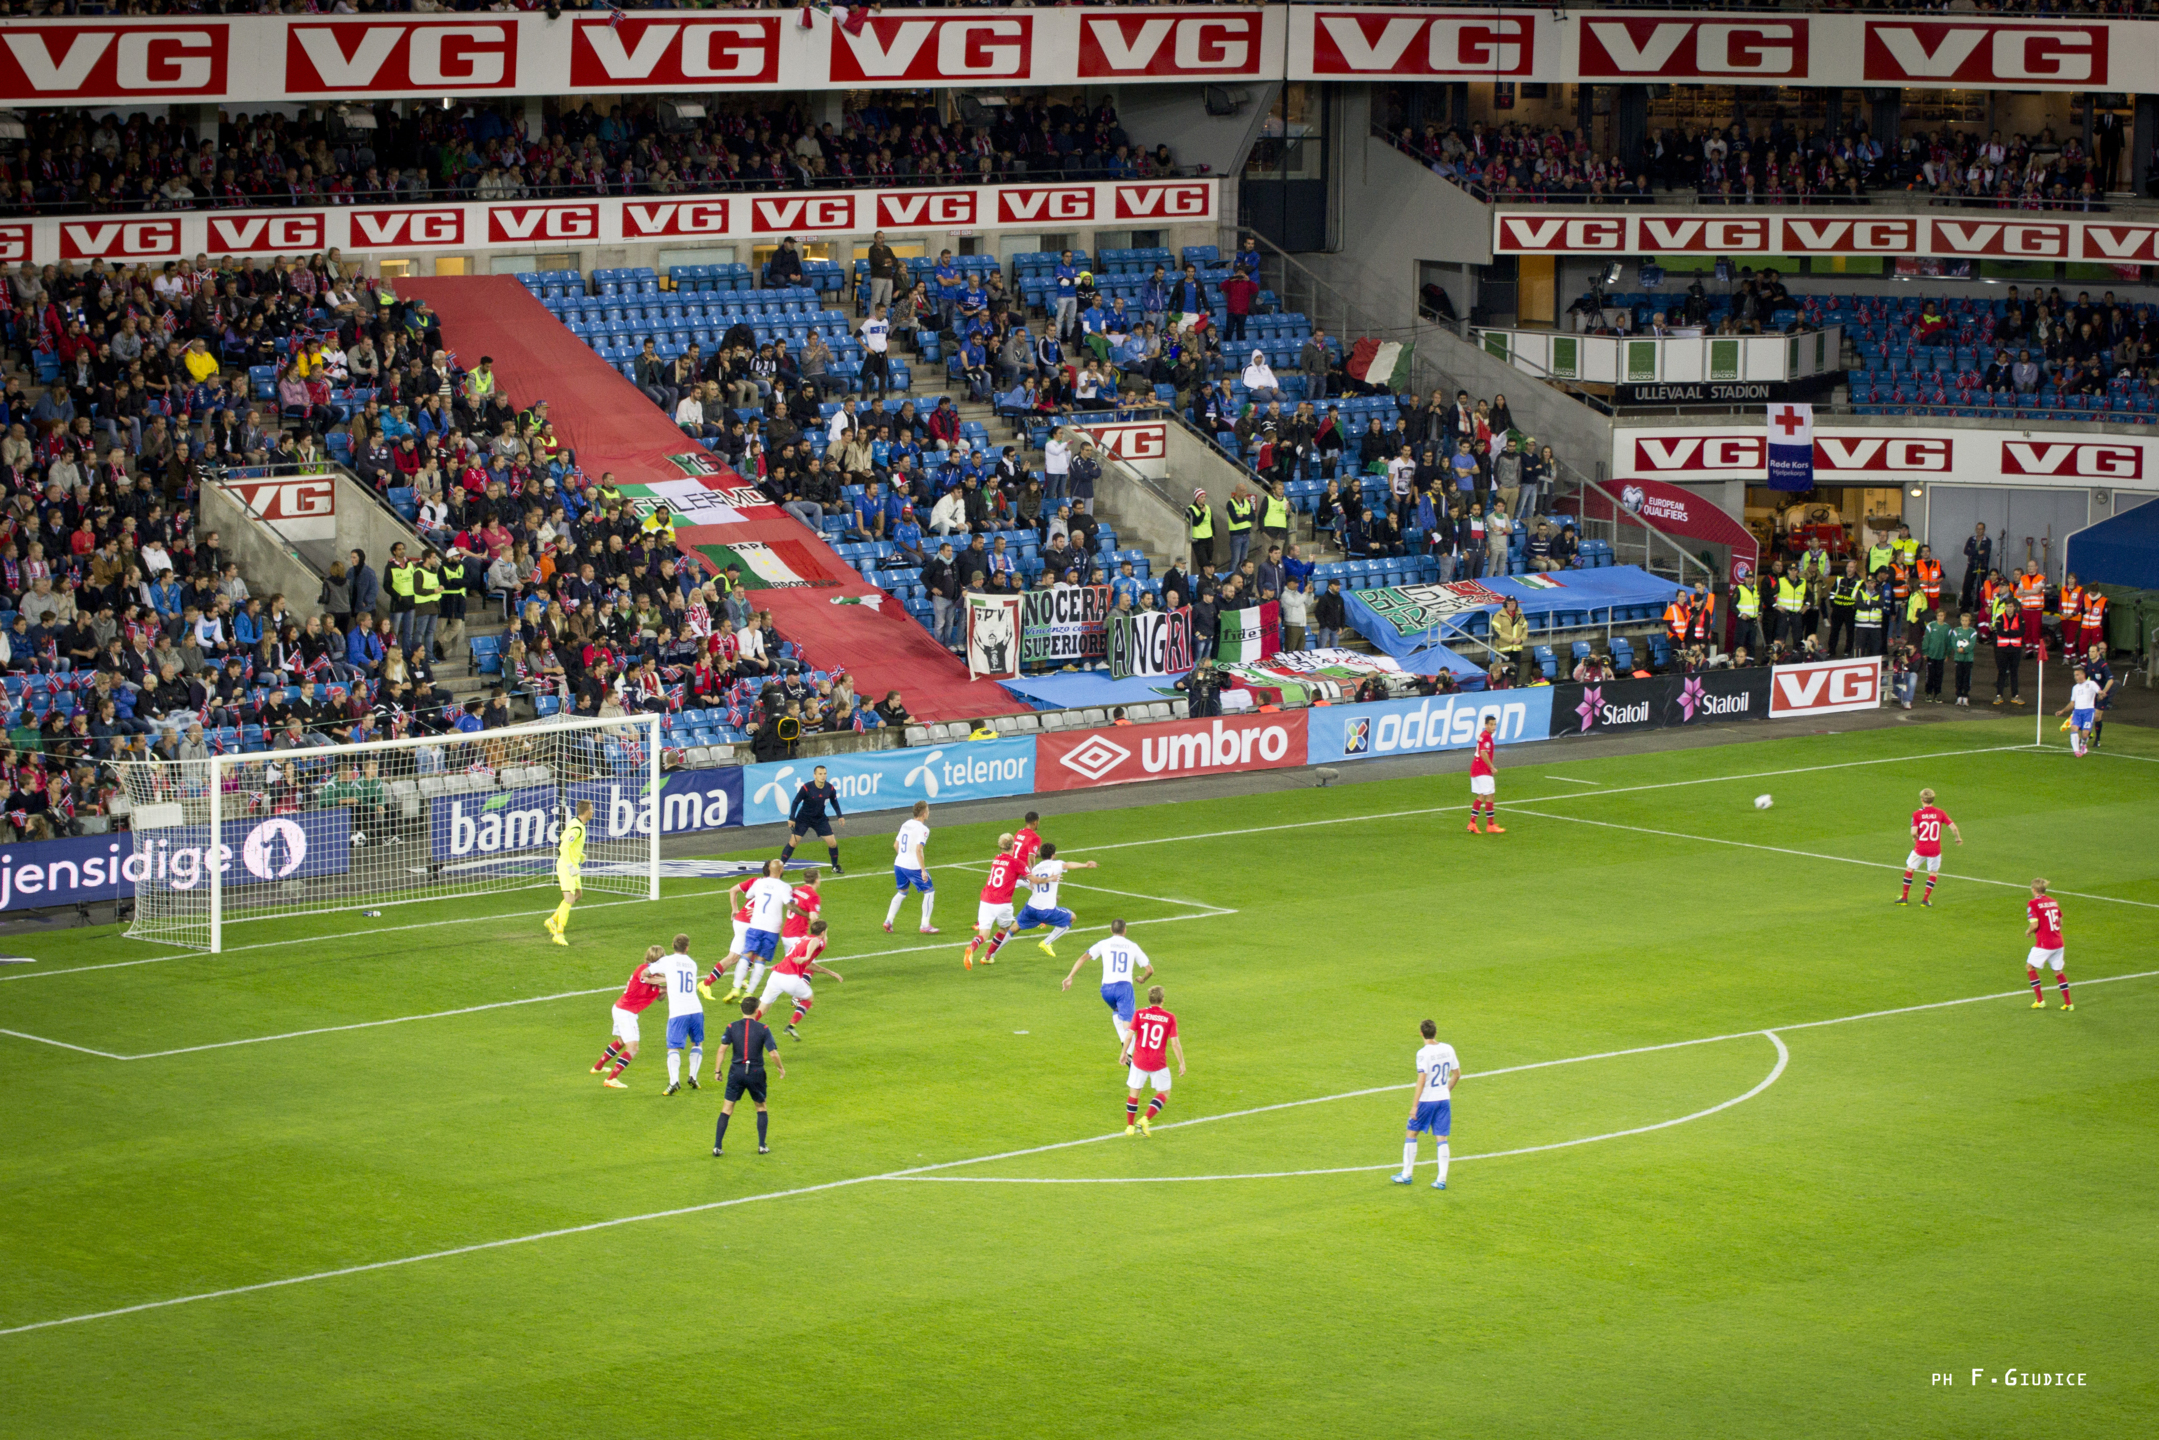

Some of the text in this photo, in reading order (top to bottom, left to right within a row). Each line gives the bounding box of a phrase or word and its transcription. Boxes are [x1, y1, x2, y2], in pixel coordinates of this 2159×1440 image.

[294, 26, 505, 86] VG
[582, 24, 765, 78] VG
[837, 14, 1021, 76] VG
[1088, 19, 1248, 69] VG
[1320, 17, 1521, 70] VG
[1588, 23, 1793, 72] VG
[1874, 28, 2092, 79] VG
[2, 32, 211, 90] VG
[757, 199, 848, 228] VG
[881, 195, 970, 223] VG
[1003, 191, 1088, 218] VG
[1120, 187, 1202, 214] VG
[212, 217, 316, 248] VG
[355, 213, 456, 243] VG
[493, 208, 591, 238] VG
[627, 203, 722, 233] VG
[65, 223, 172, 254] VG
[1505, 220, 1618, 248] VG
[1644, 221, 1760, 248] VG
[1788, 222, 1908, 249] VG
[1937, 223, 2060, 254] VG
[2087, 227, 2159, 258] V
[1635, 385, 1769, 400] ULLEVAAL STADION
[1076, 427, 1164, 459] VG
[1639, 438, 1759, 468] VG
[1817, 439, 1945, 469] VG
[1770, 459, 1809, 469] Røde Kors
[2006, 443, 2135, 476] VG
[221, 481, 332, 518] VG
[1643, 505, 1689, 522] QUALIFIERS
[1648, 497, 1685, 511] EUROPEAN
[727, 541, 773, 551] PAPA
[1024, 587, 1108, 627] NOCERA
[1024, 624, 1070, 636] Vincenzo
[1113, 610, 1192, 677] ANGRI
[1024, 633, 1107, 659] SUPERIORE
[1217, 659, 1284, 672] OLOGNA
[1777, 667, 1873, 707] VG
[1602, 700, 1650, 725] Statoil
[1702, 691, 1749, 715] Statoil
[1375, 696, 1526, 752] oddsen
[2083, 721, 2091, 729] 23
[1142, 719, 1288, 773] umbro
[943, 756, 1028, 786] telenor
[608, 784, 728, 837] bama
[901, 833, 909, 854] 9
[1919, 821, 1941, 841] 20
[1014, 841, 1023, 859] 7
[988, 867, 1006, 888] 18
[763, 893, 772, 914] 7
[2045, 909, 2060, 931] 15
[1110, 951, 1128, 973] 19
[677, 970, 693, 993] 16
[1141, 1022, 1164, 1050] 19
[1431, 1062, 1450, 1088] 20
